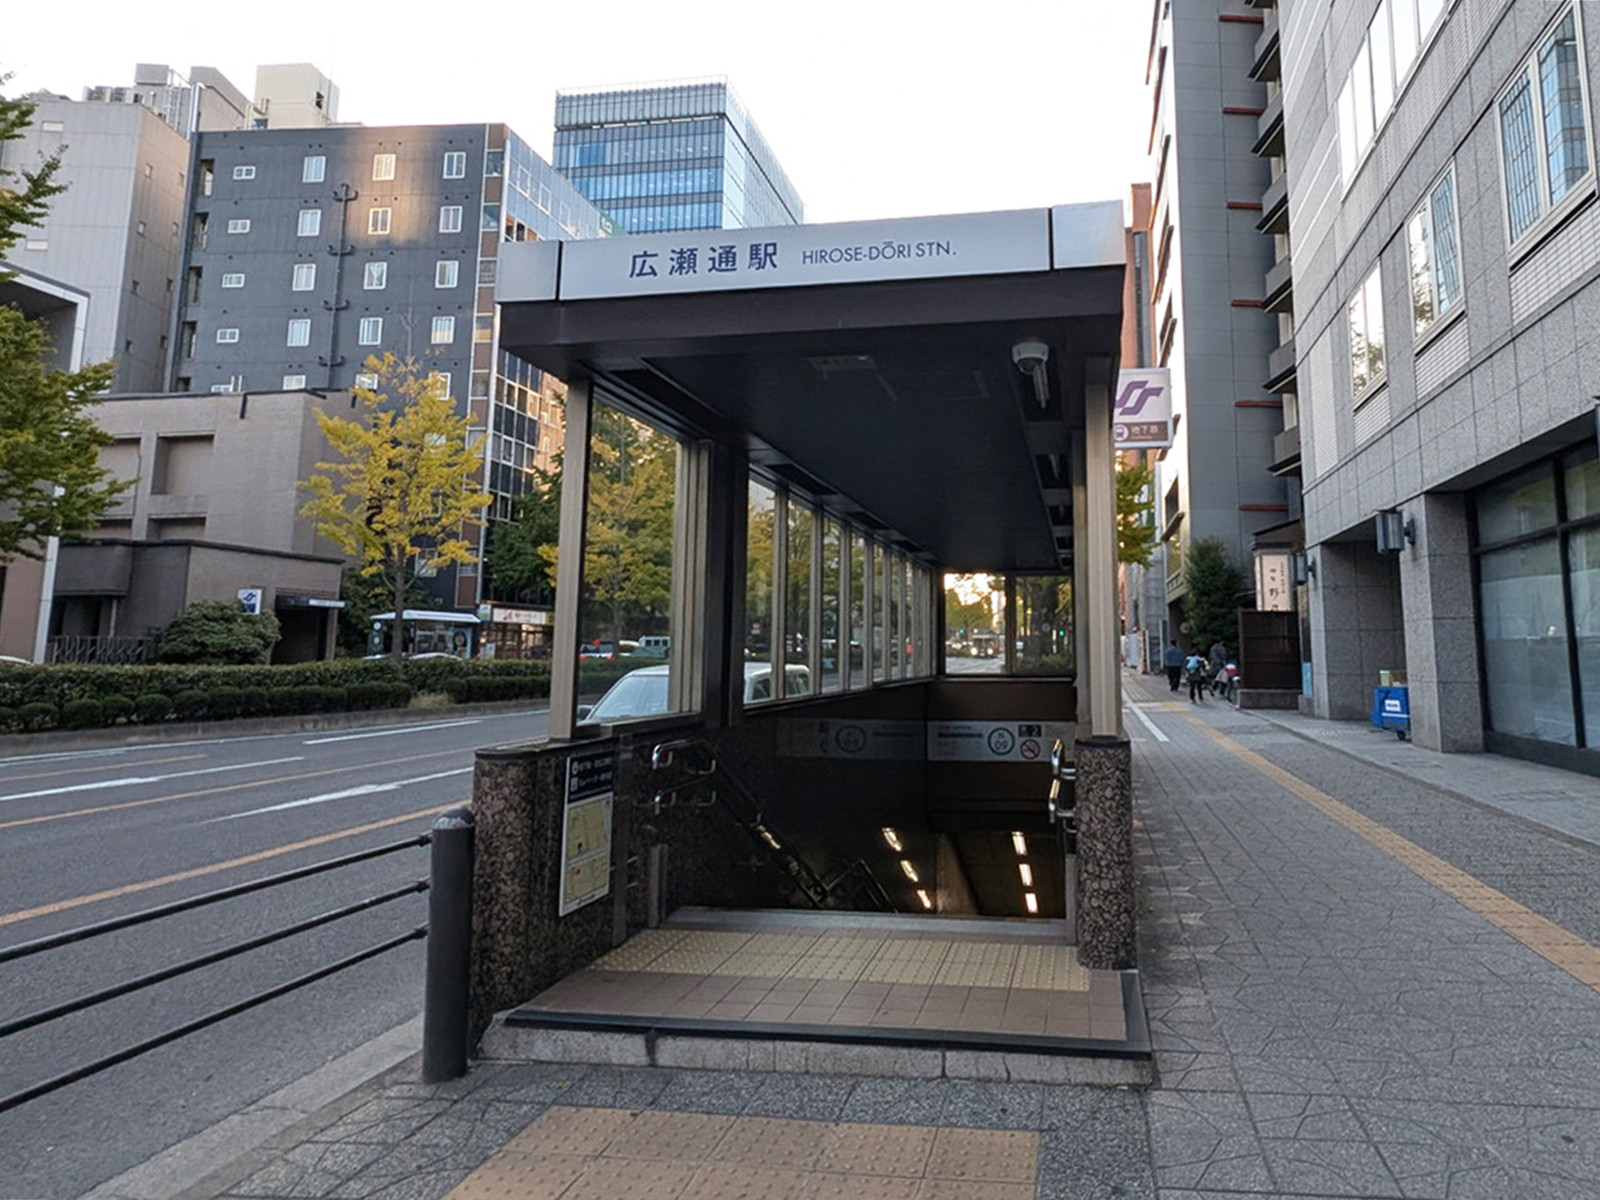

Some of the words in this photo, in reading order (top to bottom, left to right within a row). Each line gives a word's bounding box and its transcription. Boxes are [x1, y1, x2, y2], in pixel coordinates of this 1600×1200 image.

[629, 242, 778, 278] 広瀬通駅
[802, 241, 911, 265] HIROSE-DŌRI
[915, 240, 957, 258] STN.
